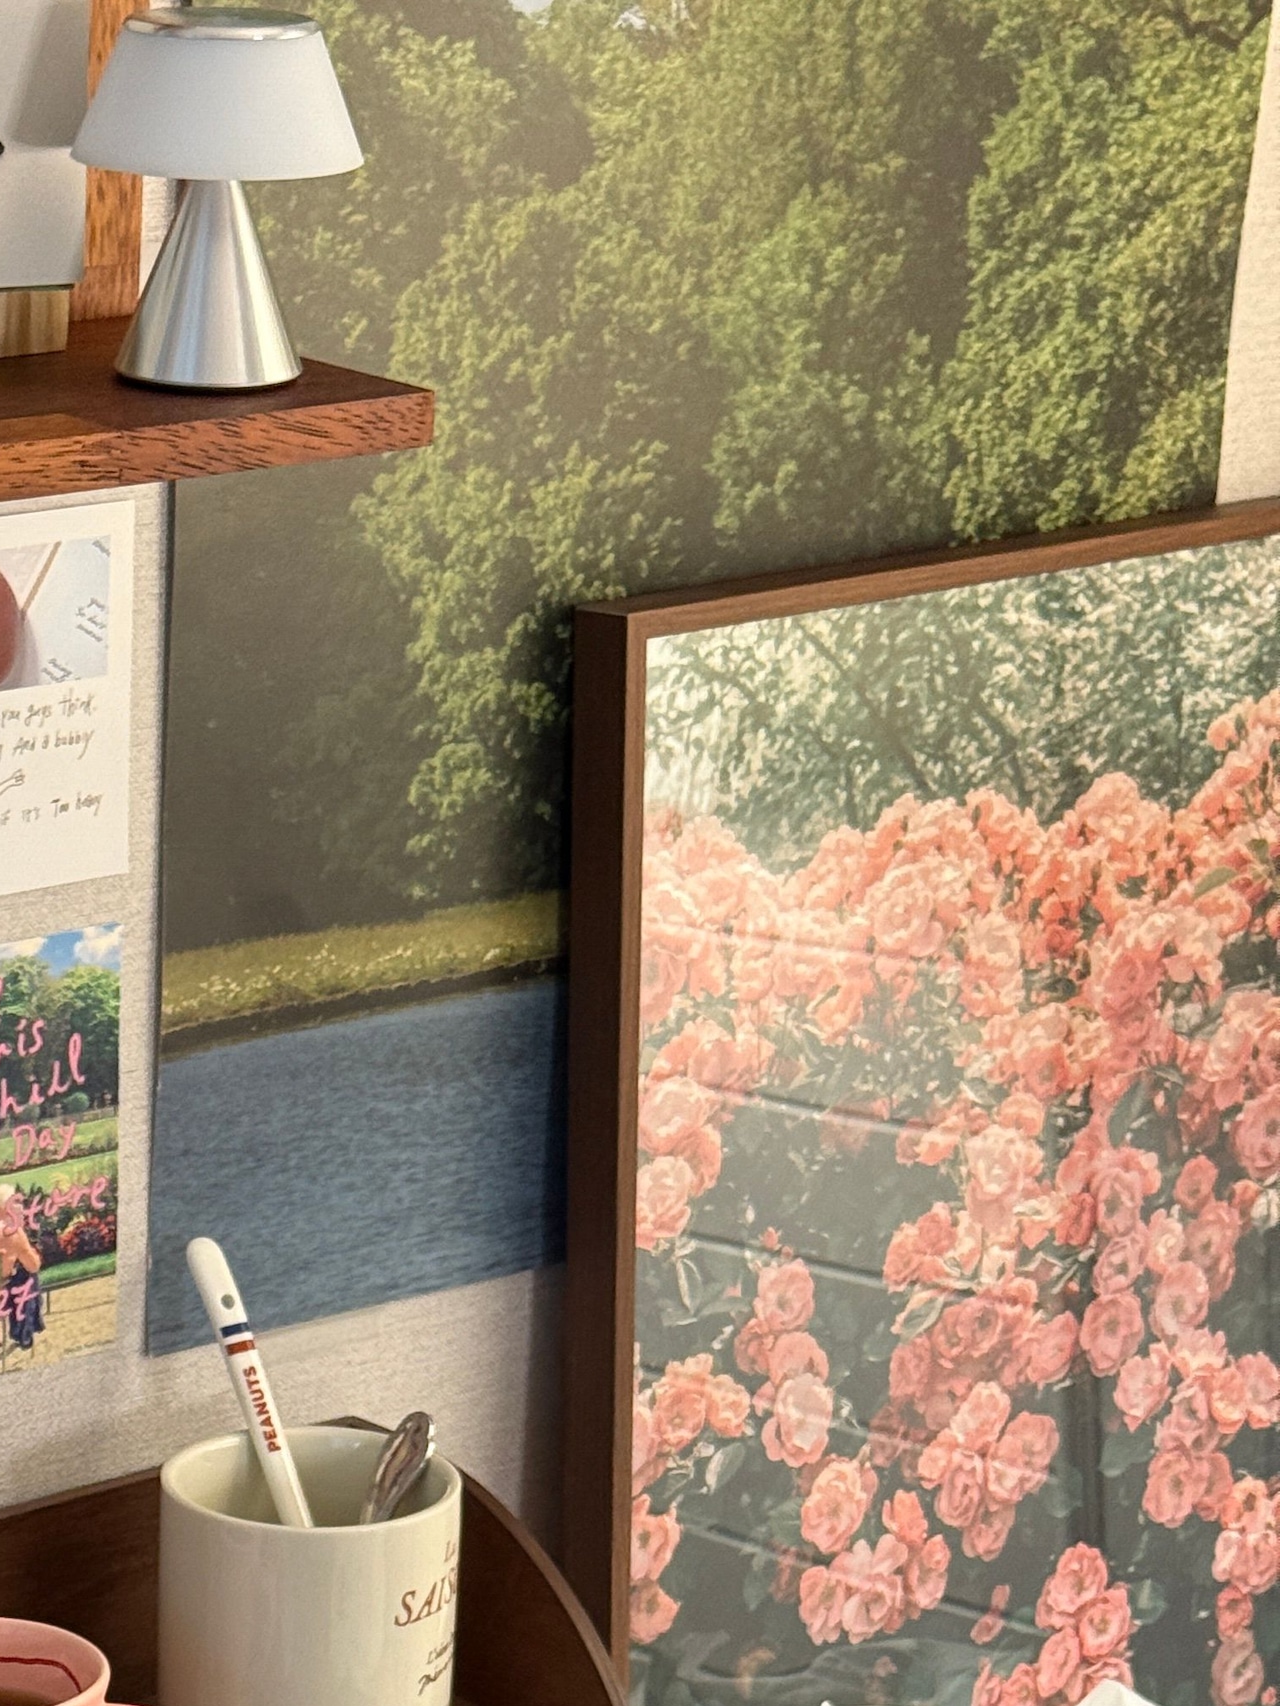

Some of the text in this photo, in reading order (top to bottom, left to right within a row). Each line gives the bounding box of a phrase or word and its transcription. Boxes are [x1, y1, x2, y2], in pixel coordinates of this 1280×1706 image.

[1, 709, 20, 728] you
[25, 704, 52, 728] guys
[12, 1121, 77, 1171] Day
[243, 1364, 282, 1454] PEANUTS
